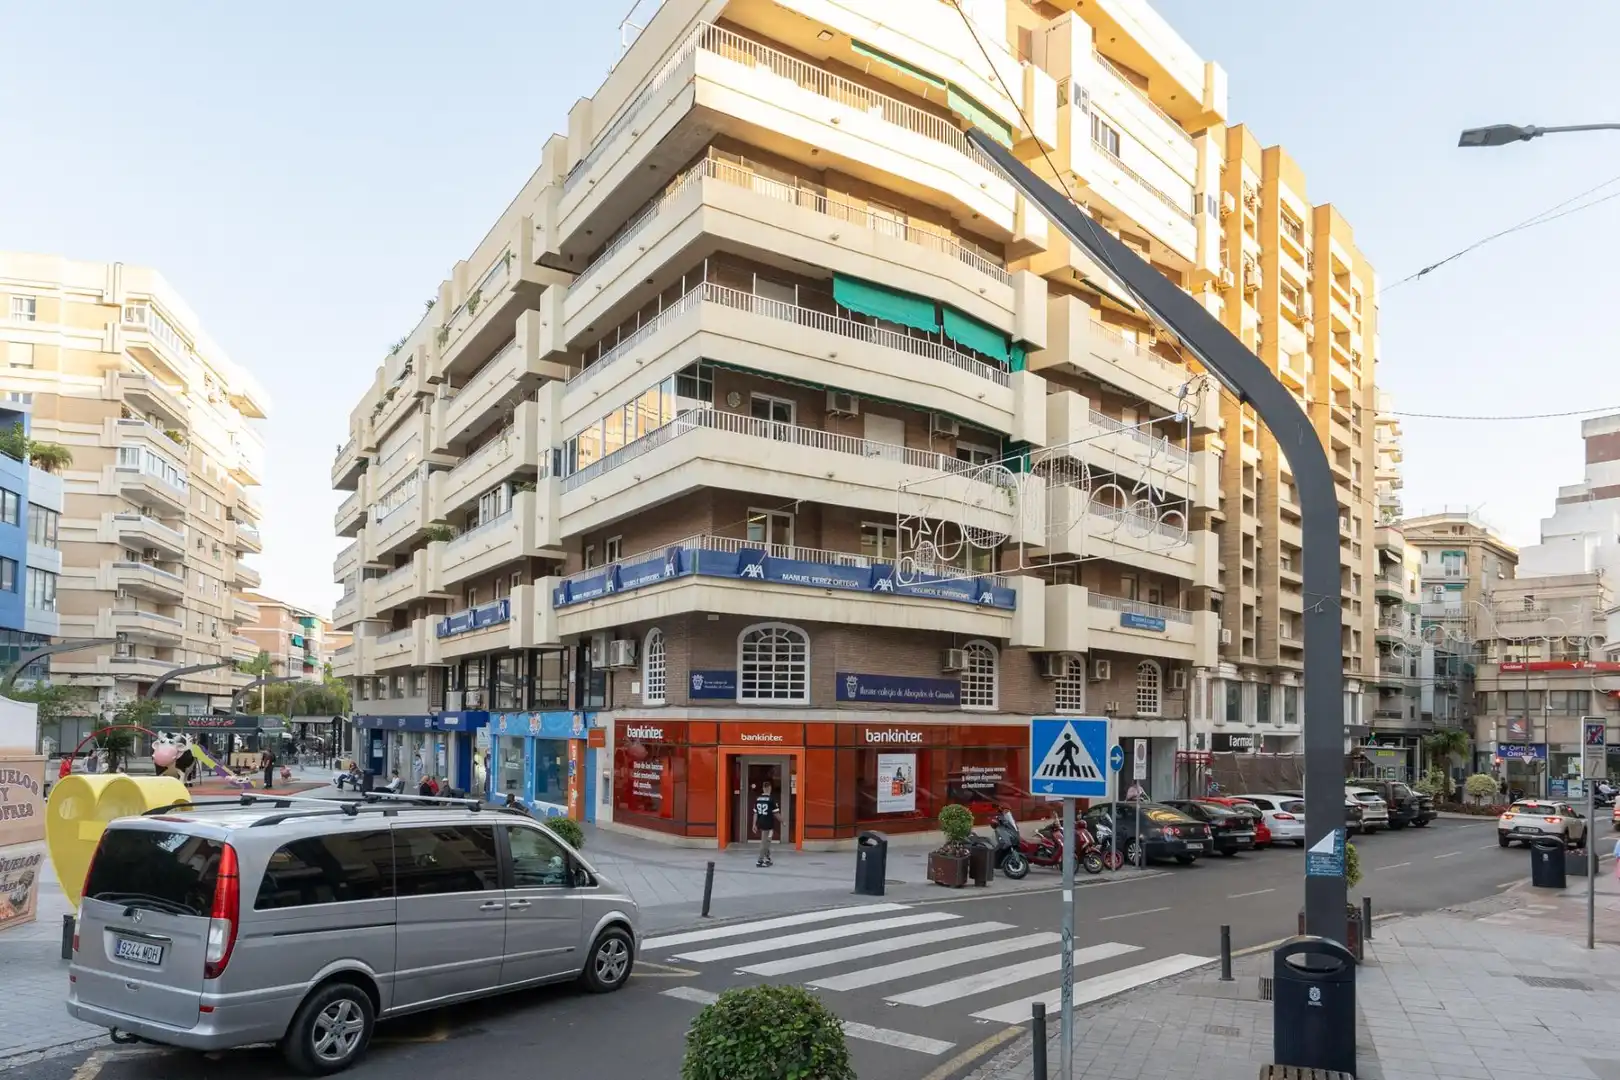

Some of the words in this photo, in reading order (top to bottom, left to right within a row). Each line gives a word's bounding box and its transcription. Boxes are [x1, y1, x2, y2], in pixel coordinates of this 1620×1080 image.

[741, 563, 765, 579] AXA
[782, 573, 811, 584] MANUEL
[833, 579, 860, 588] ORTEGA
[873, 578, 894, 592] AXA
[979, 591, 994, 605] AXA
[756, 803, 768, 815] 92
[121, 942, 140, 957] 9244
